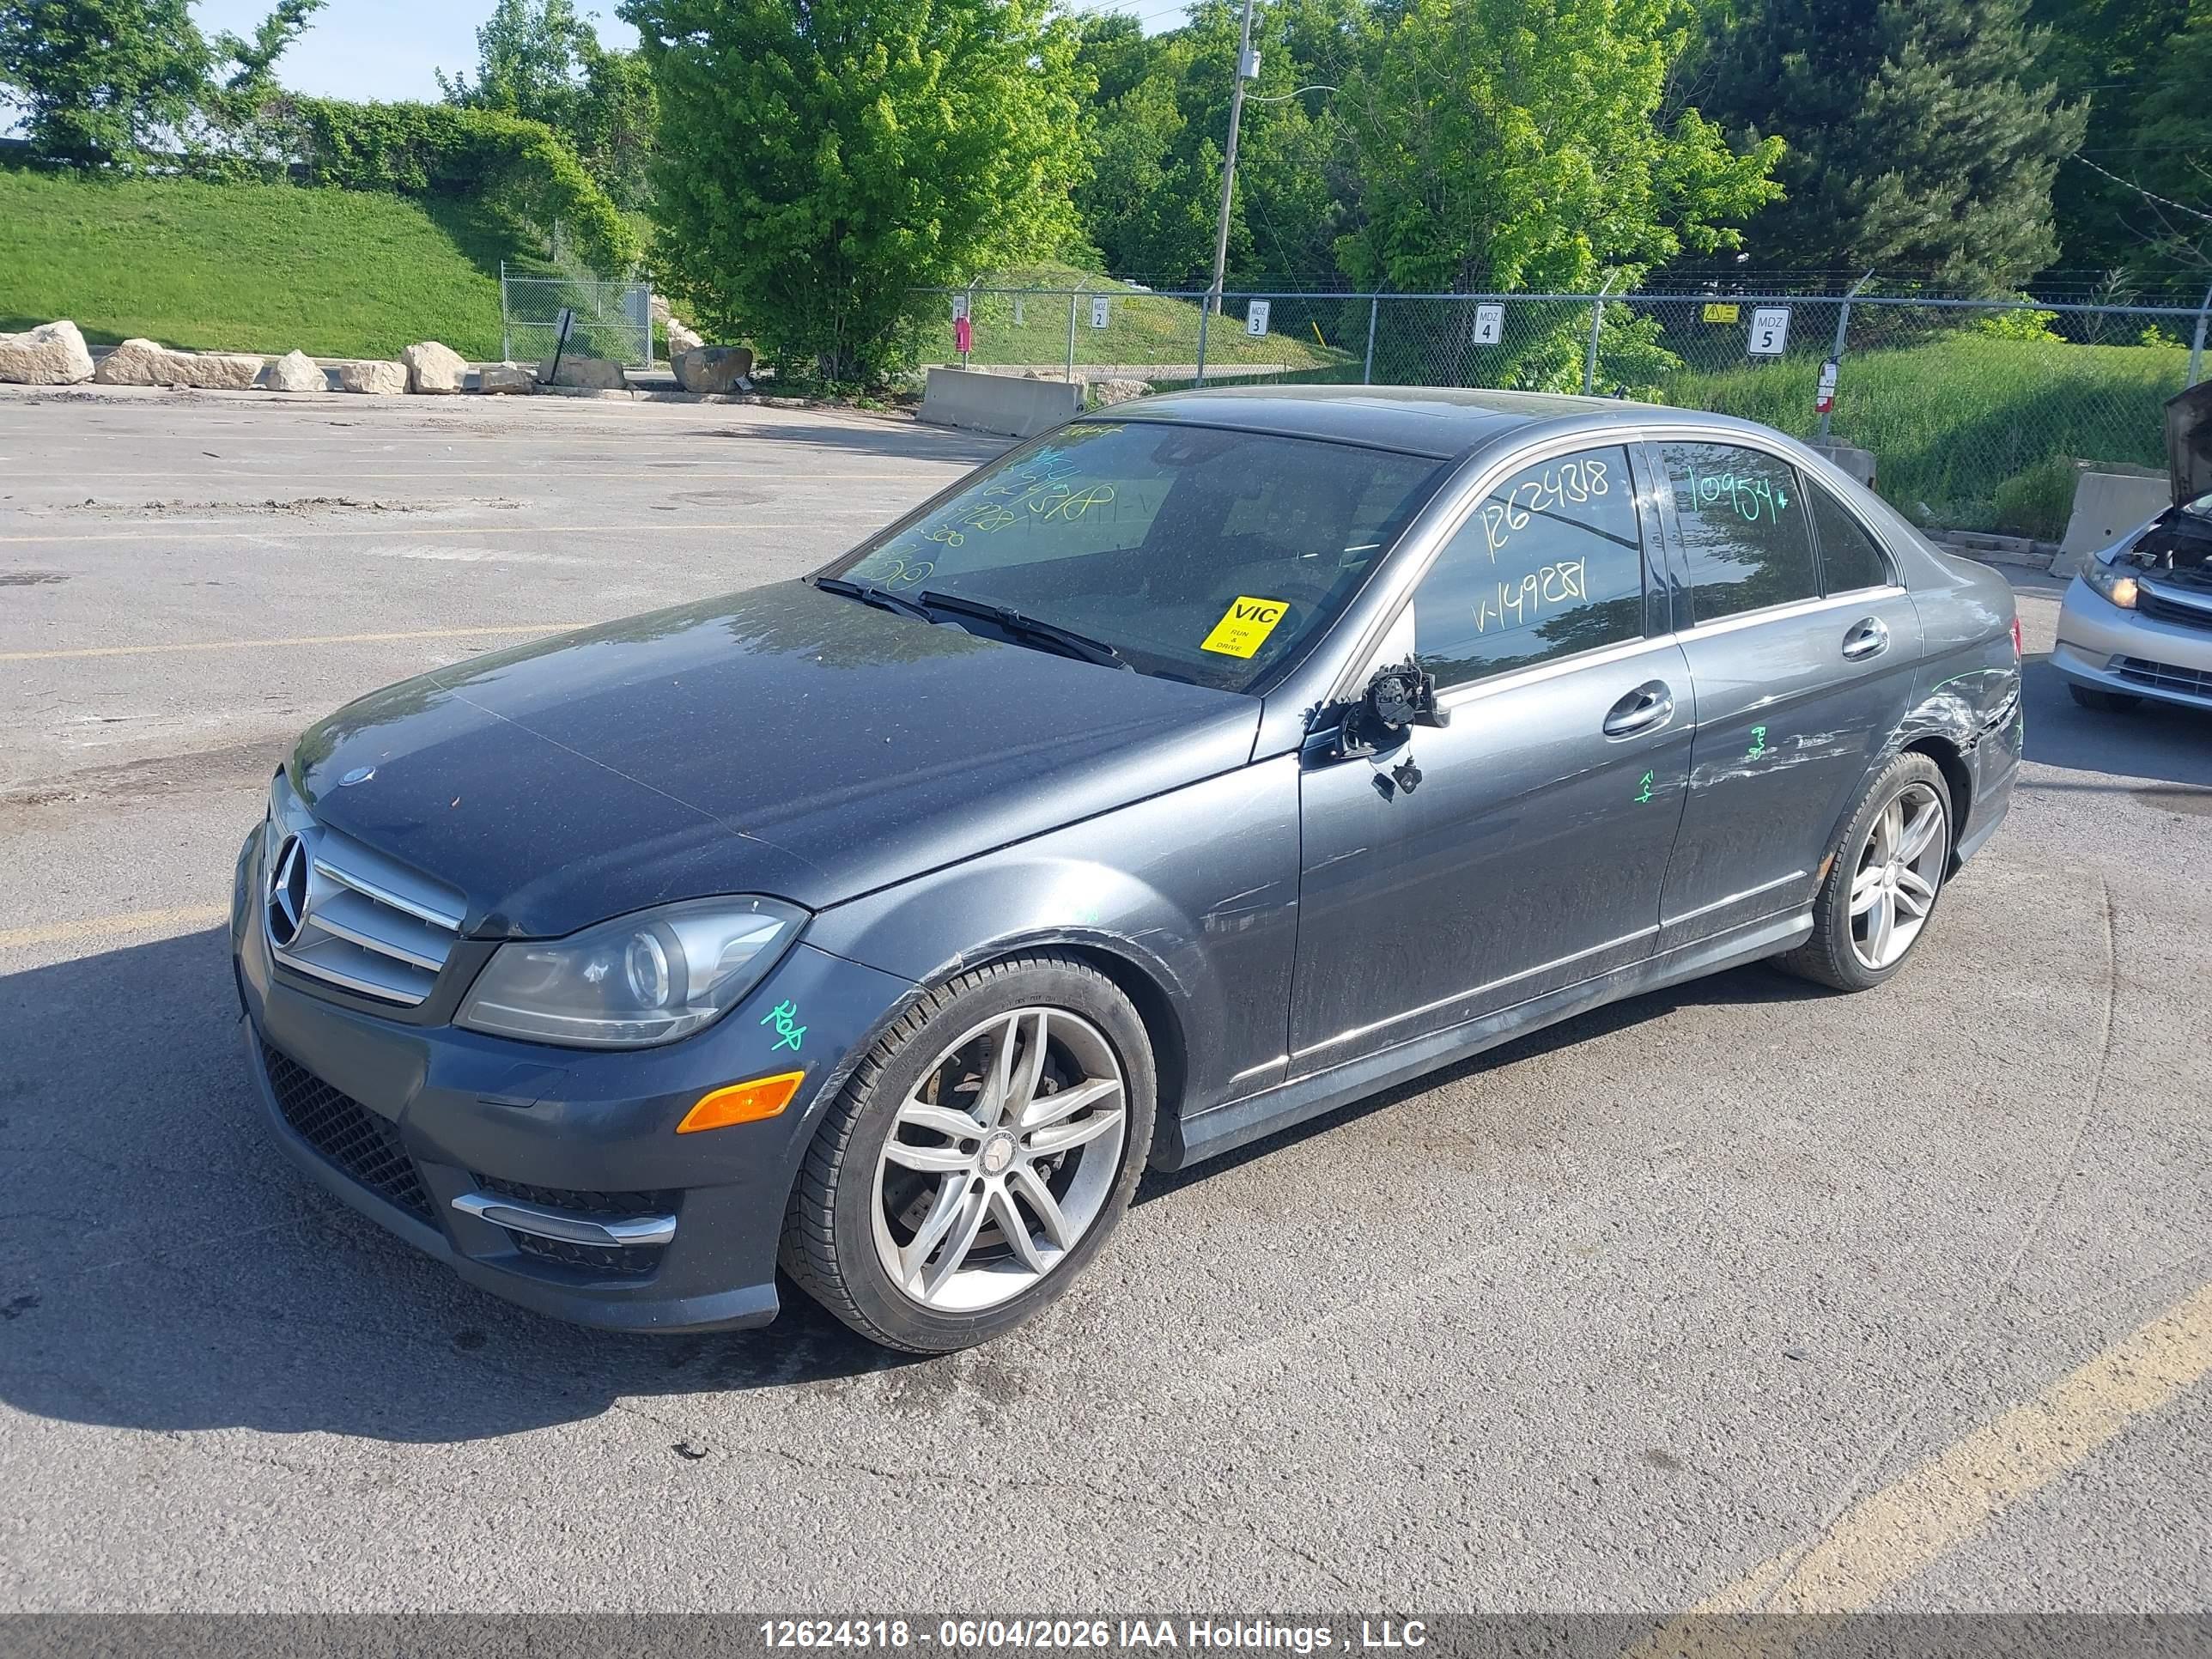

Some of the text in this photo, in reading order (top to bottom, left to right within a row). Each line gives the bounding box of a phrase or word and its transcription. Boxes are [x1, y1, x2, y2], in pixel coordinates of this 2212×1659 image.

[1251, 307, 1267, 316] MDZ
[1480, 312, 1498, 322] MDZ
[1096, 313, 1103, 325] 2
[1253, 319, 1260, 331] 3
[1757, 316, 1784, 328] MDZ
[1482, 324, 1491, 339] 4
[1761, 331, 1773, 348] 5
[1482, 459, 1608, 564] 12624318
[1235, 604, 1279, 623] VIC
[1216, 642, 1243, 652] DRIVE
